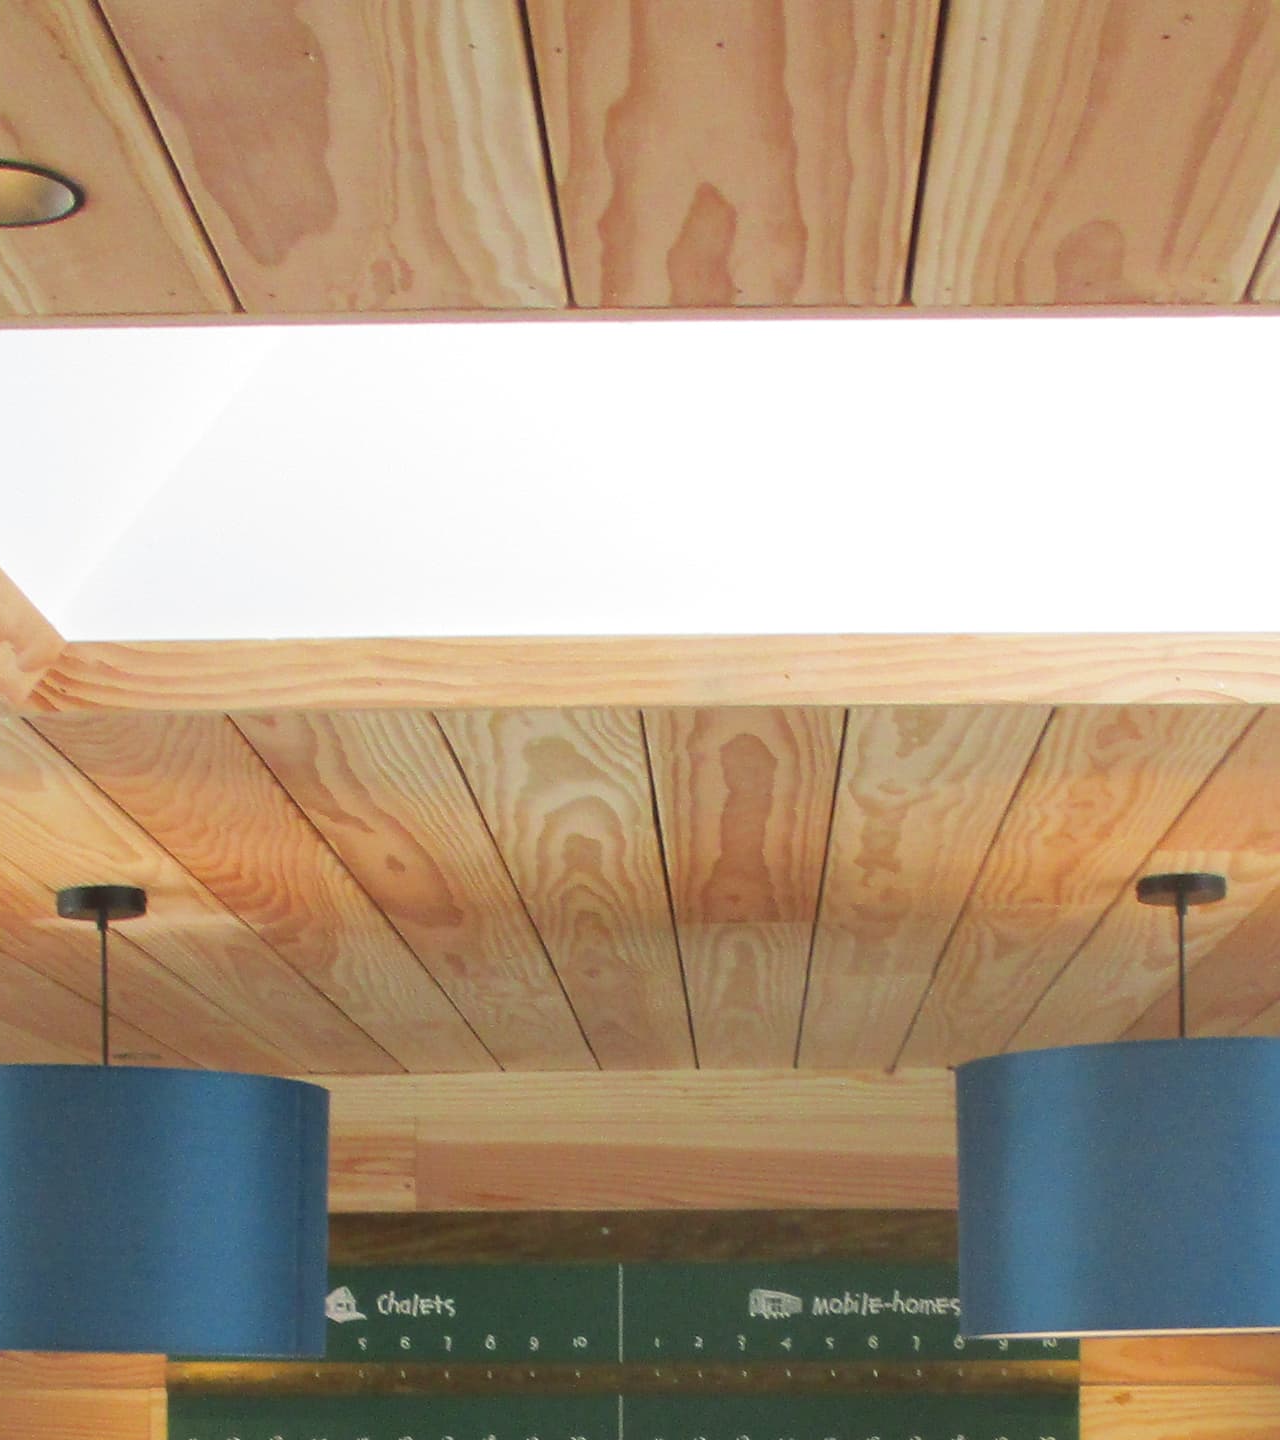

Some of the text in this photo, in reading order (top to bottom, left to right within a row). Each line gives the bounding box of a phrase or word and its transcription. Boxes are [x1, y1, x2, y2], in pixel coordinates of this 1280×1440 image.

[376, 1290, 456, 1318] Chalets
[357, 1334, 588, 1352] 5 6 7 8 9 10
[694, 1335, 704, 1348] 2
[737, 1334, 747, 1351] 3
[825, 1336, 835, 1349] 5
[867, 1334, 879, 1349] 6
[912, 1335, 921, 1351] 7
[953, 1335, 967, 1350] 8
